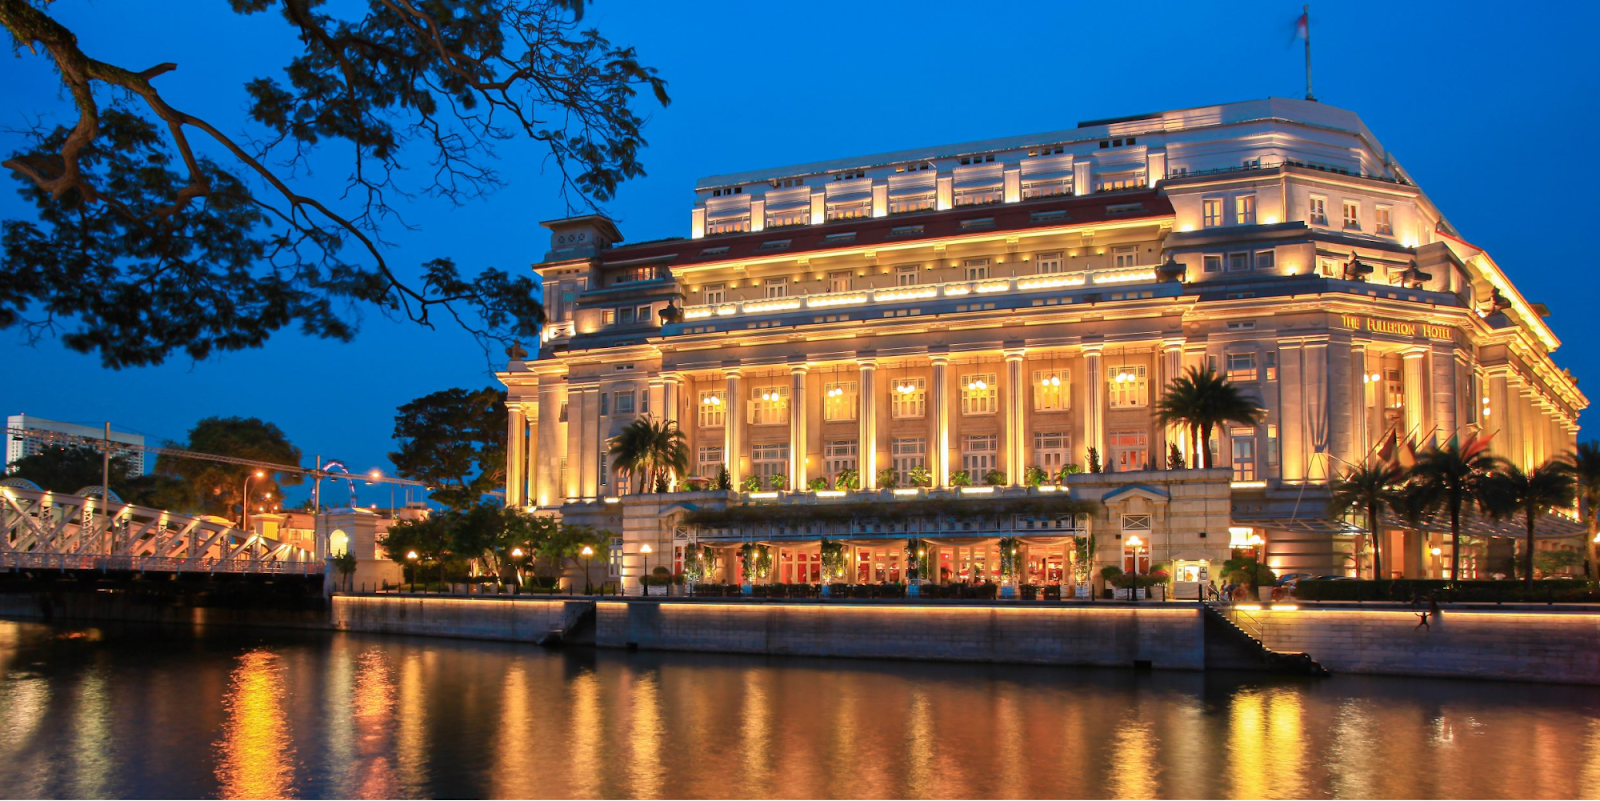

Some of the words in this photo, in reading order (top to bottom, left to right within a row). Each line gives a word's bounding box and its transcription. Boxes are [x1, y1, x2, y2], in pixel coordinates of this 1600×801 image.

[1341, 315, 1360, 329] THE
[1367, 318, 1416, 335] FULLERTON
[1422, 324, 1452, 339] HOTEL
